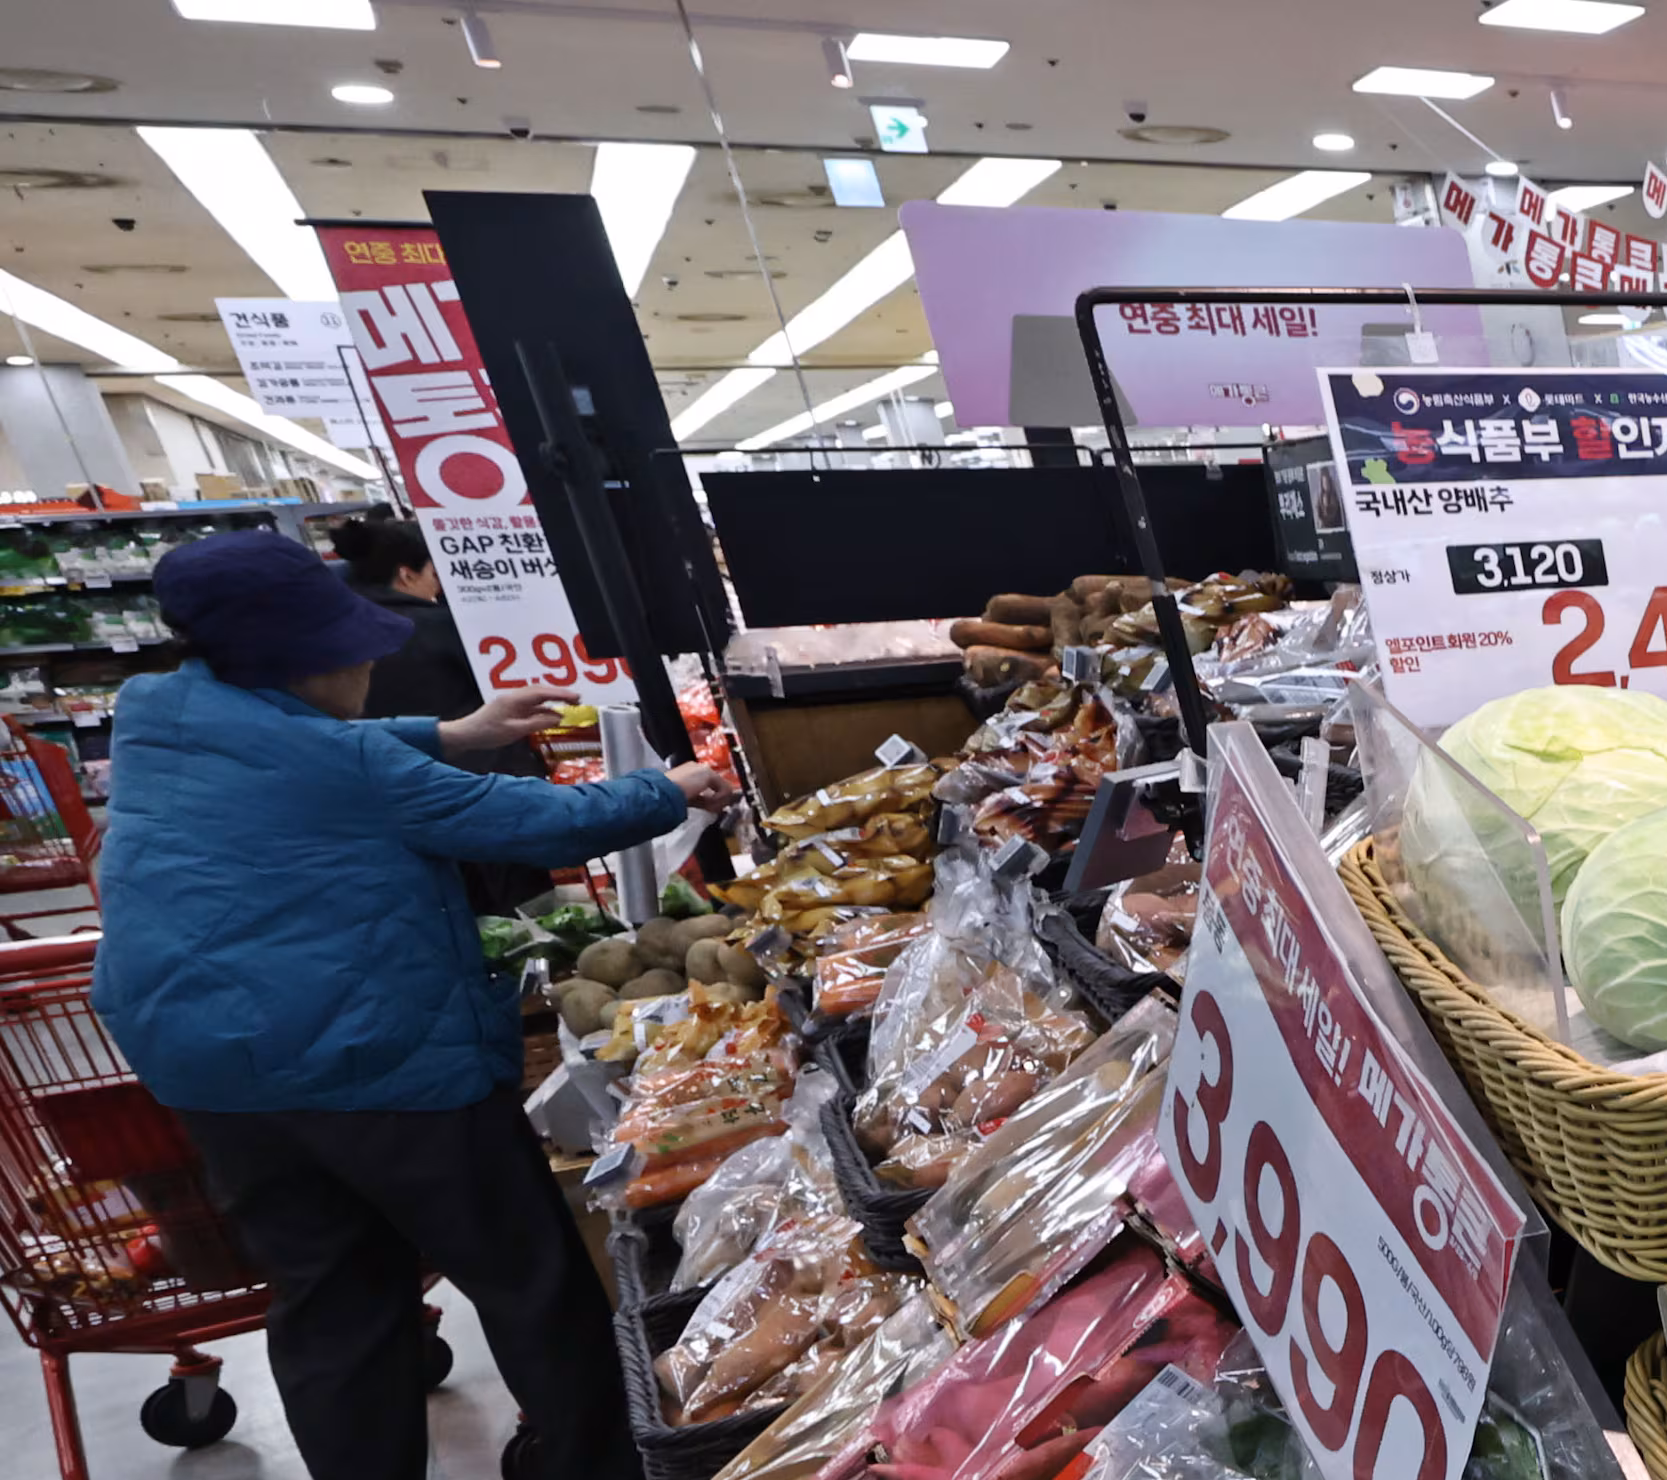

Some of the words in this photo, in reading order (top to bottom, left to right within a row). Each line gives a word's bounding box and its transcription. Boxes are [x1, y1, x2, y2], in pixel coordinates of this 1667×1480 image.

[1519, 187, 1545, 226] 메
[1646, 172, 1667, 209] 메
[1443, 180, 1476, 225] 메
[1488, 211, 1515, 253] 가
[1529, 237, 1561, 281] 통
[344, 241, 397, 265] 연중
[338, 281, 464, 371] 메
[1119, 302, 1182, 335] 연중
[1186, 302, 1247, 337] 최대
[1252, 306, 1319, 338] 세일!
[1390, 419, 1564, 466] 농식품부
[1355, 489, 1434, 517] 국내산
[1438, 486, 1514, 515] 양배추
[432, 517, 474, 533] 쫄깃한
[477, 516, 509, 532] 식감,
[440, 535, 494, 555] GAP
[449, 557, 518, 581] 새송이
[1370, 569, 1411, 585] 정상가
[1473, 542, 1584, 588] 3,120
[1385, 635, 1447, 655] 엘포인트
[1448, 632, 1478, 650] 회원
[1479, 630, 1514, 647] 20%
[1390, 656, 1421, 674] 할인
[1225, 813, 1264, 917] 연중
[1260, 886, 1302, 996] 최대
[1296, 965, 1352, 1089] 세일!
[1357, 1047, 1492, 1267] 메가통큰
